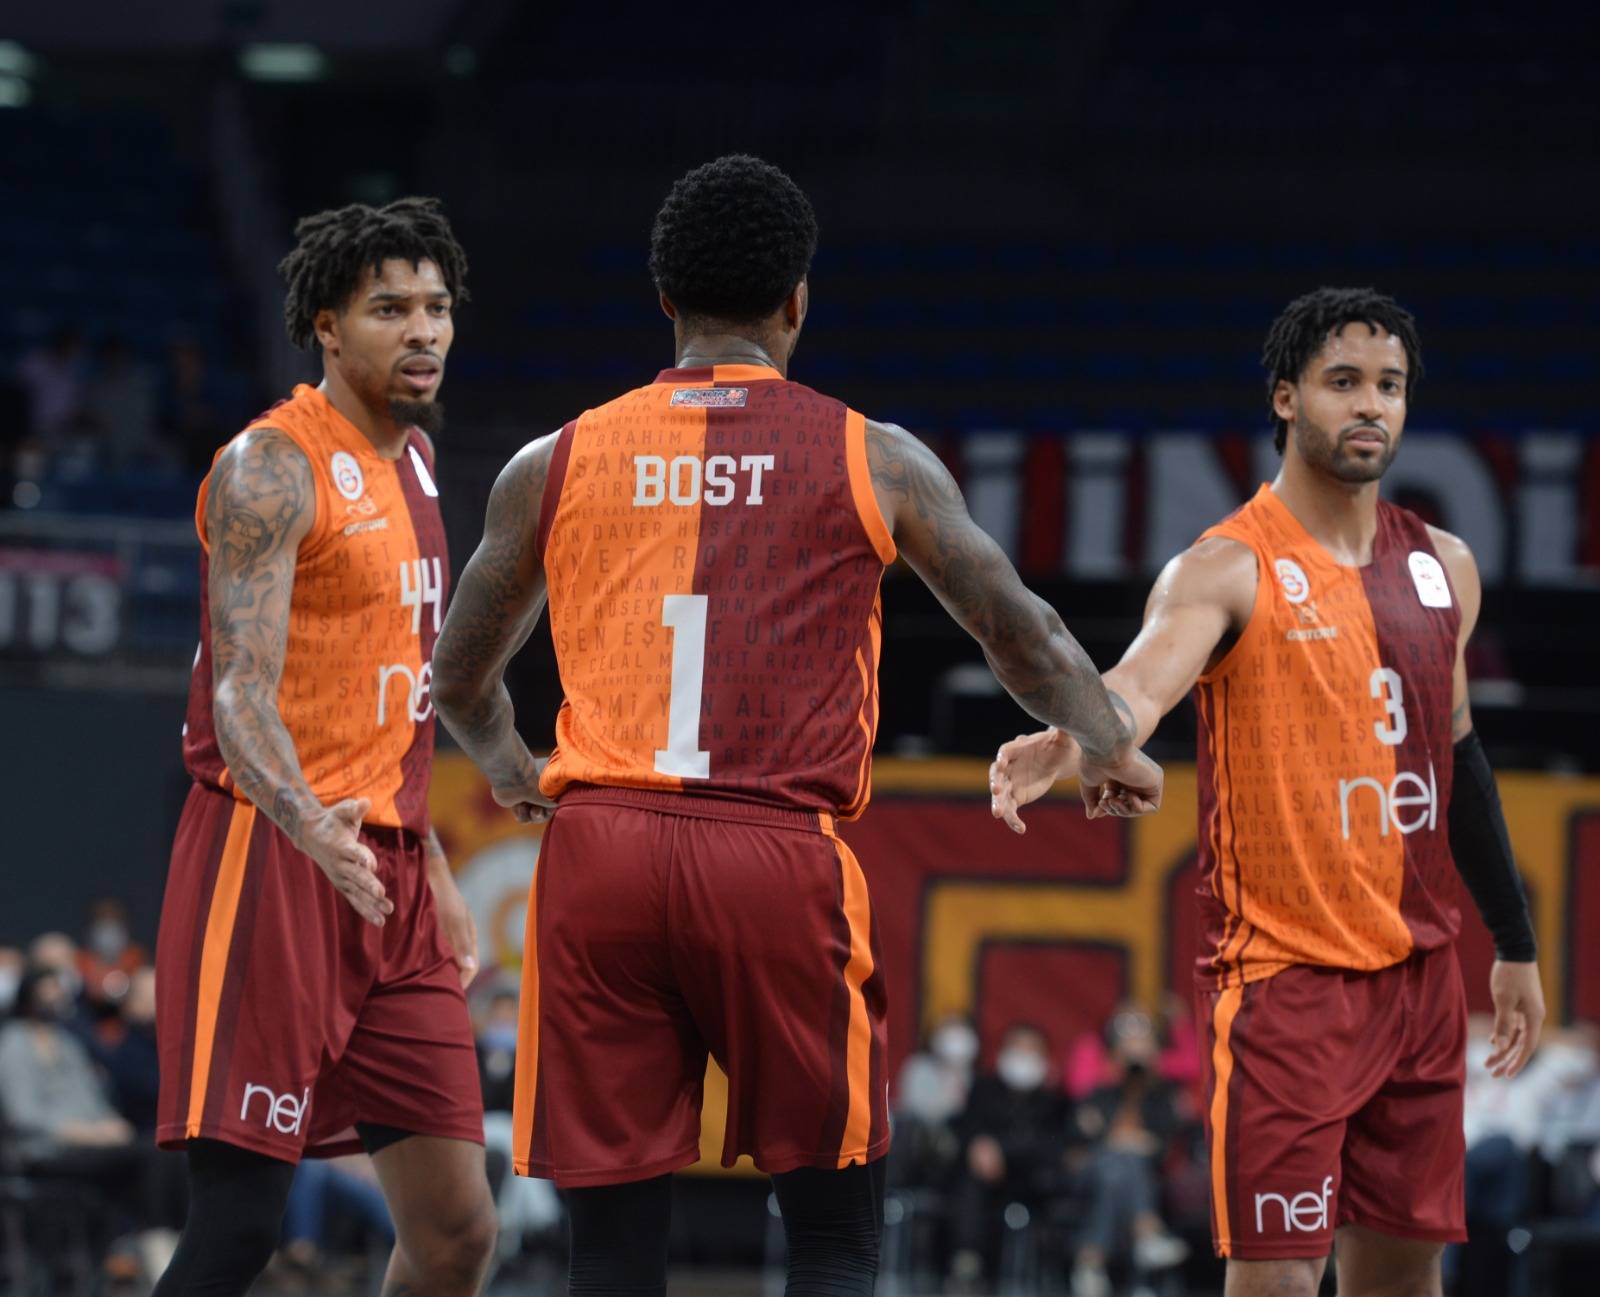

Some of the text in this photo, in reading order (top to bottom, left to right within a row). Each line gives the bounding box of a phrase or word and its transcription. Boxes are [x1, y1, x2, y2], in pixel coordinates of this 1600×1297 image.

[633, 455, 774, 507] BOST
[594, 521, 662, 542] DAVER
[401, 557, 443, 635] 44
[377, 661, 433, 727] ne
[654, 594, 710, 779] 1
[1370, 668, 1408, 746] 3
[1255, 1175, 1333, 1233] nef
